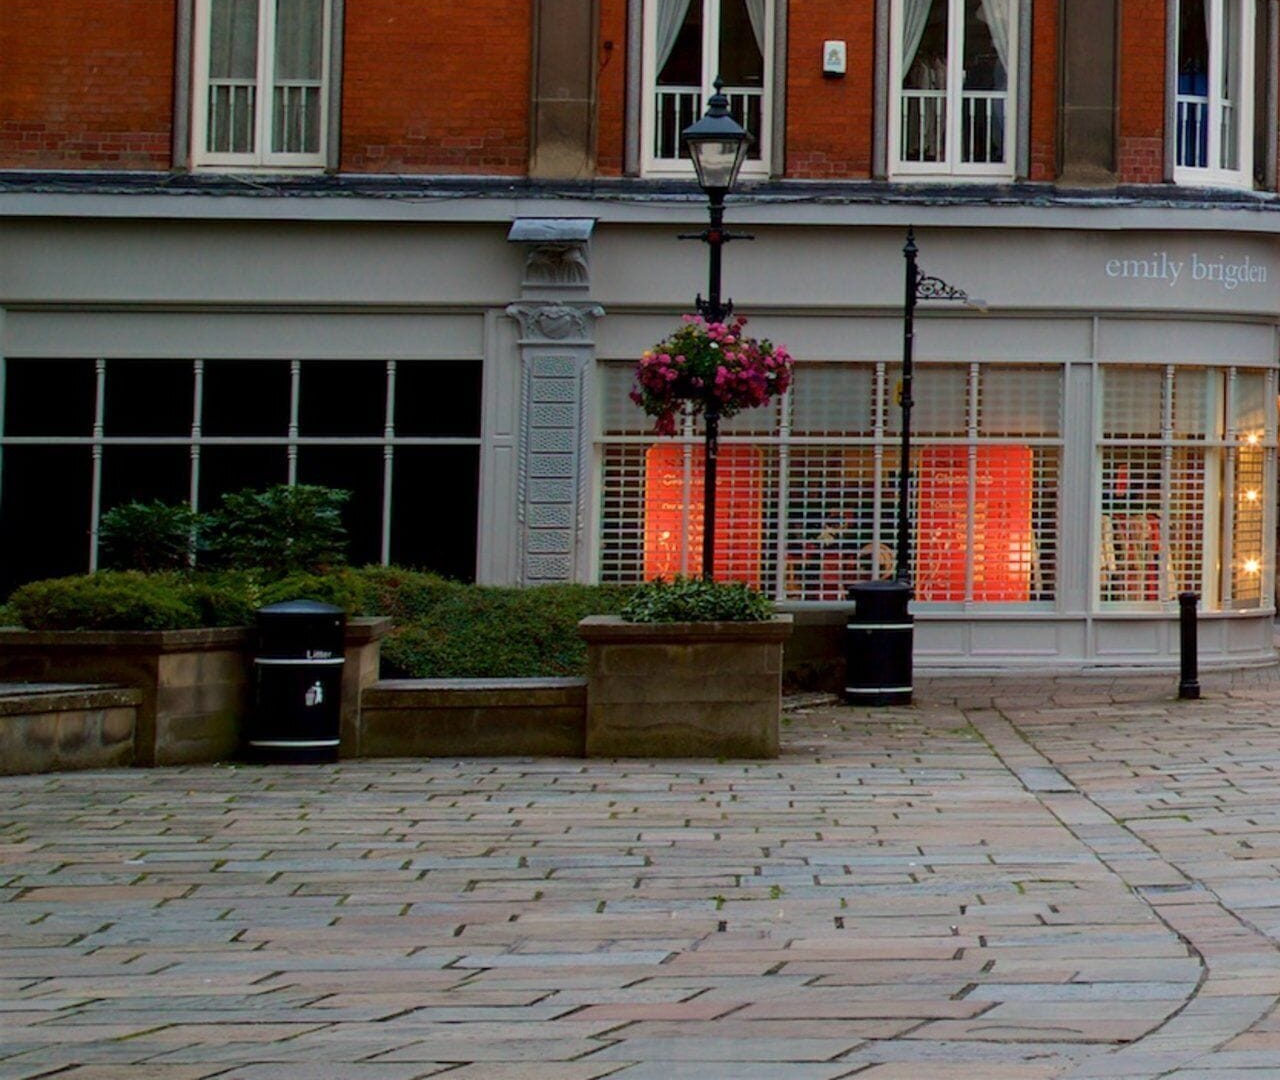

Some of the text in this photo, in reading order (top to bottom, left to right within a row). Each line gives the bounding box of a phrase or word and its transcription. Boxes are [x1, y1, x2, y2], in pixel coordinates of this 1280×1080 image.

[1105, 251, 1267, 290] emily brigden
[307, 649, 332, 659] Litter
